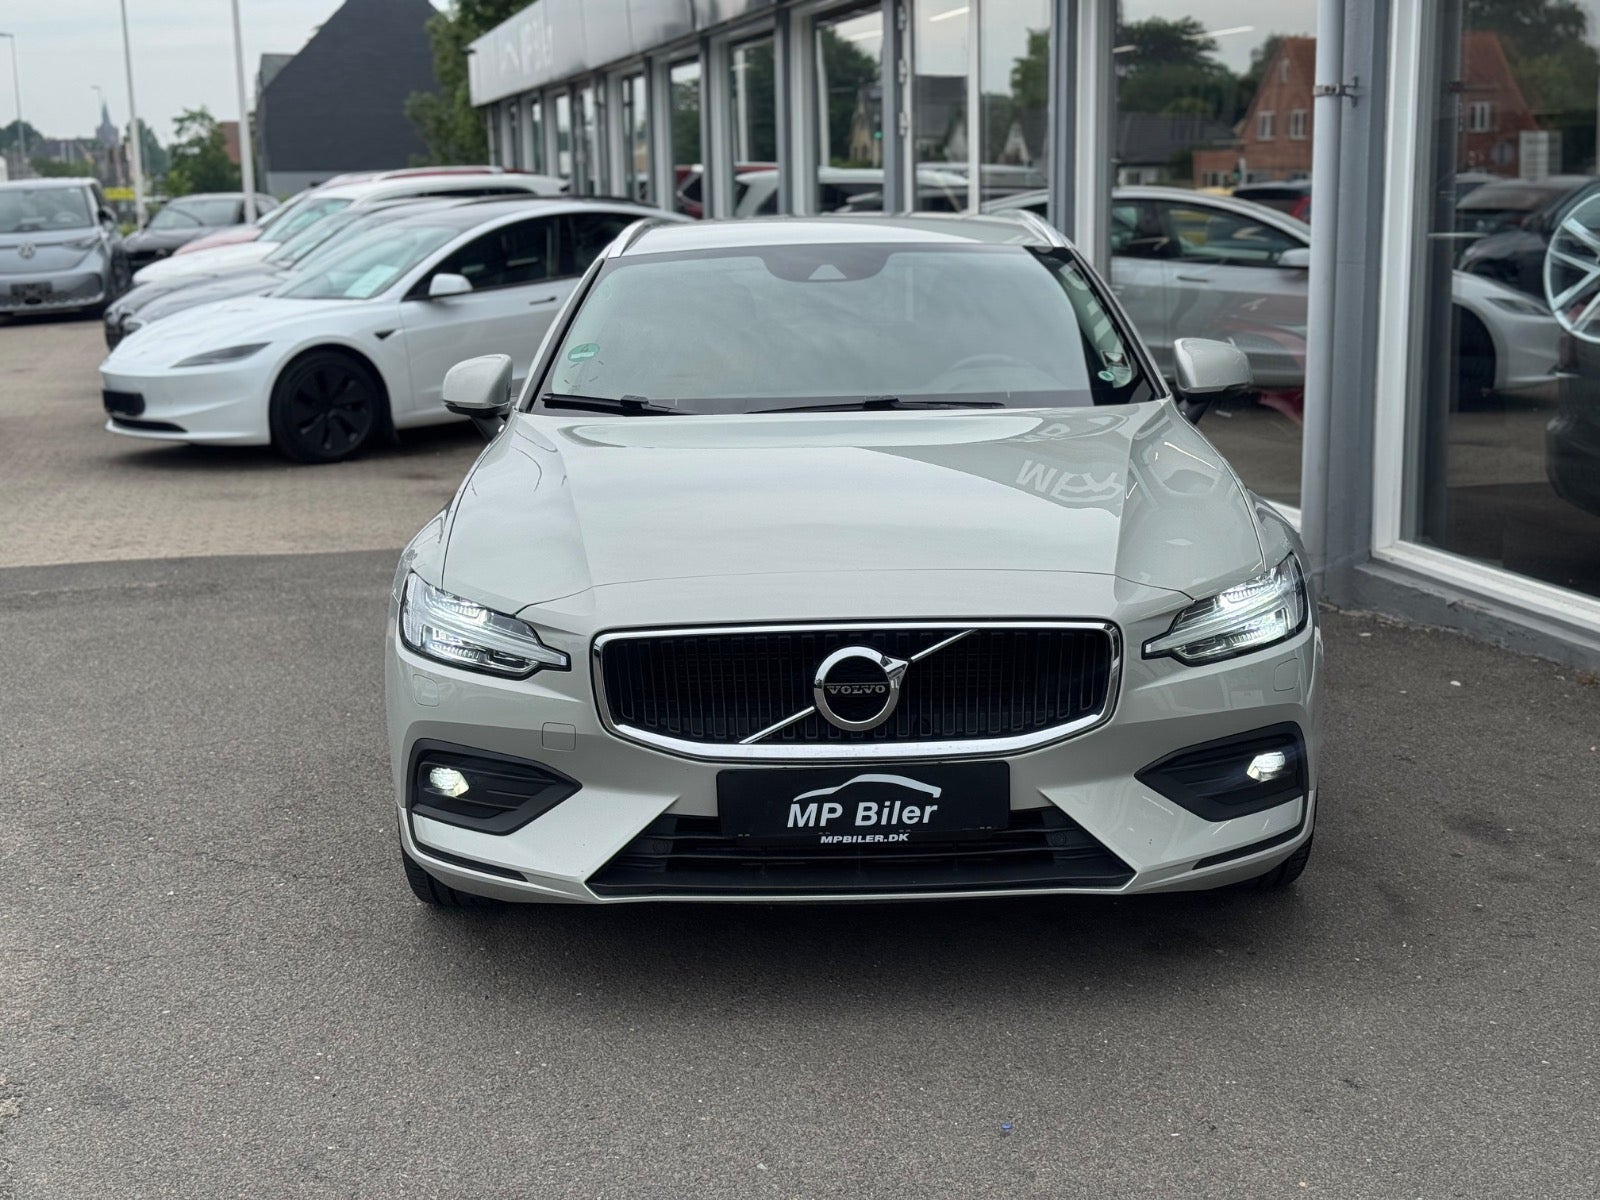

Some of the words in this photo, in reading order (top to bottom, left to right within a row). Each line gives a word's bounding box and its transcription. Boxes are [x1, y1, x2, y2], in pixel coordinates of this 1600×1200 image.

[826, 684, 886, 694] VOLVO
[787, 802, 843, 828] MP
[854, 800, 938, 826] Biler
[820, 833, 910, 844] MPBILER.DK
